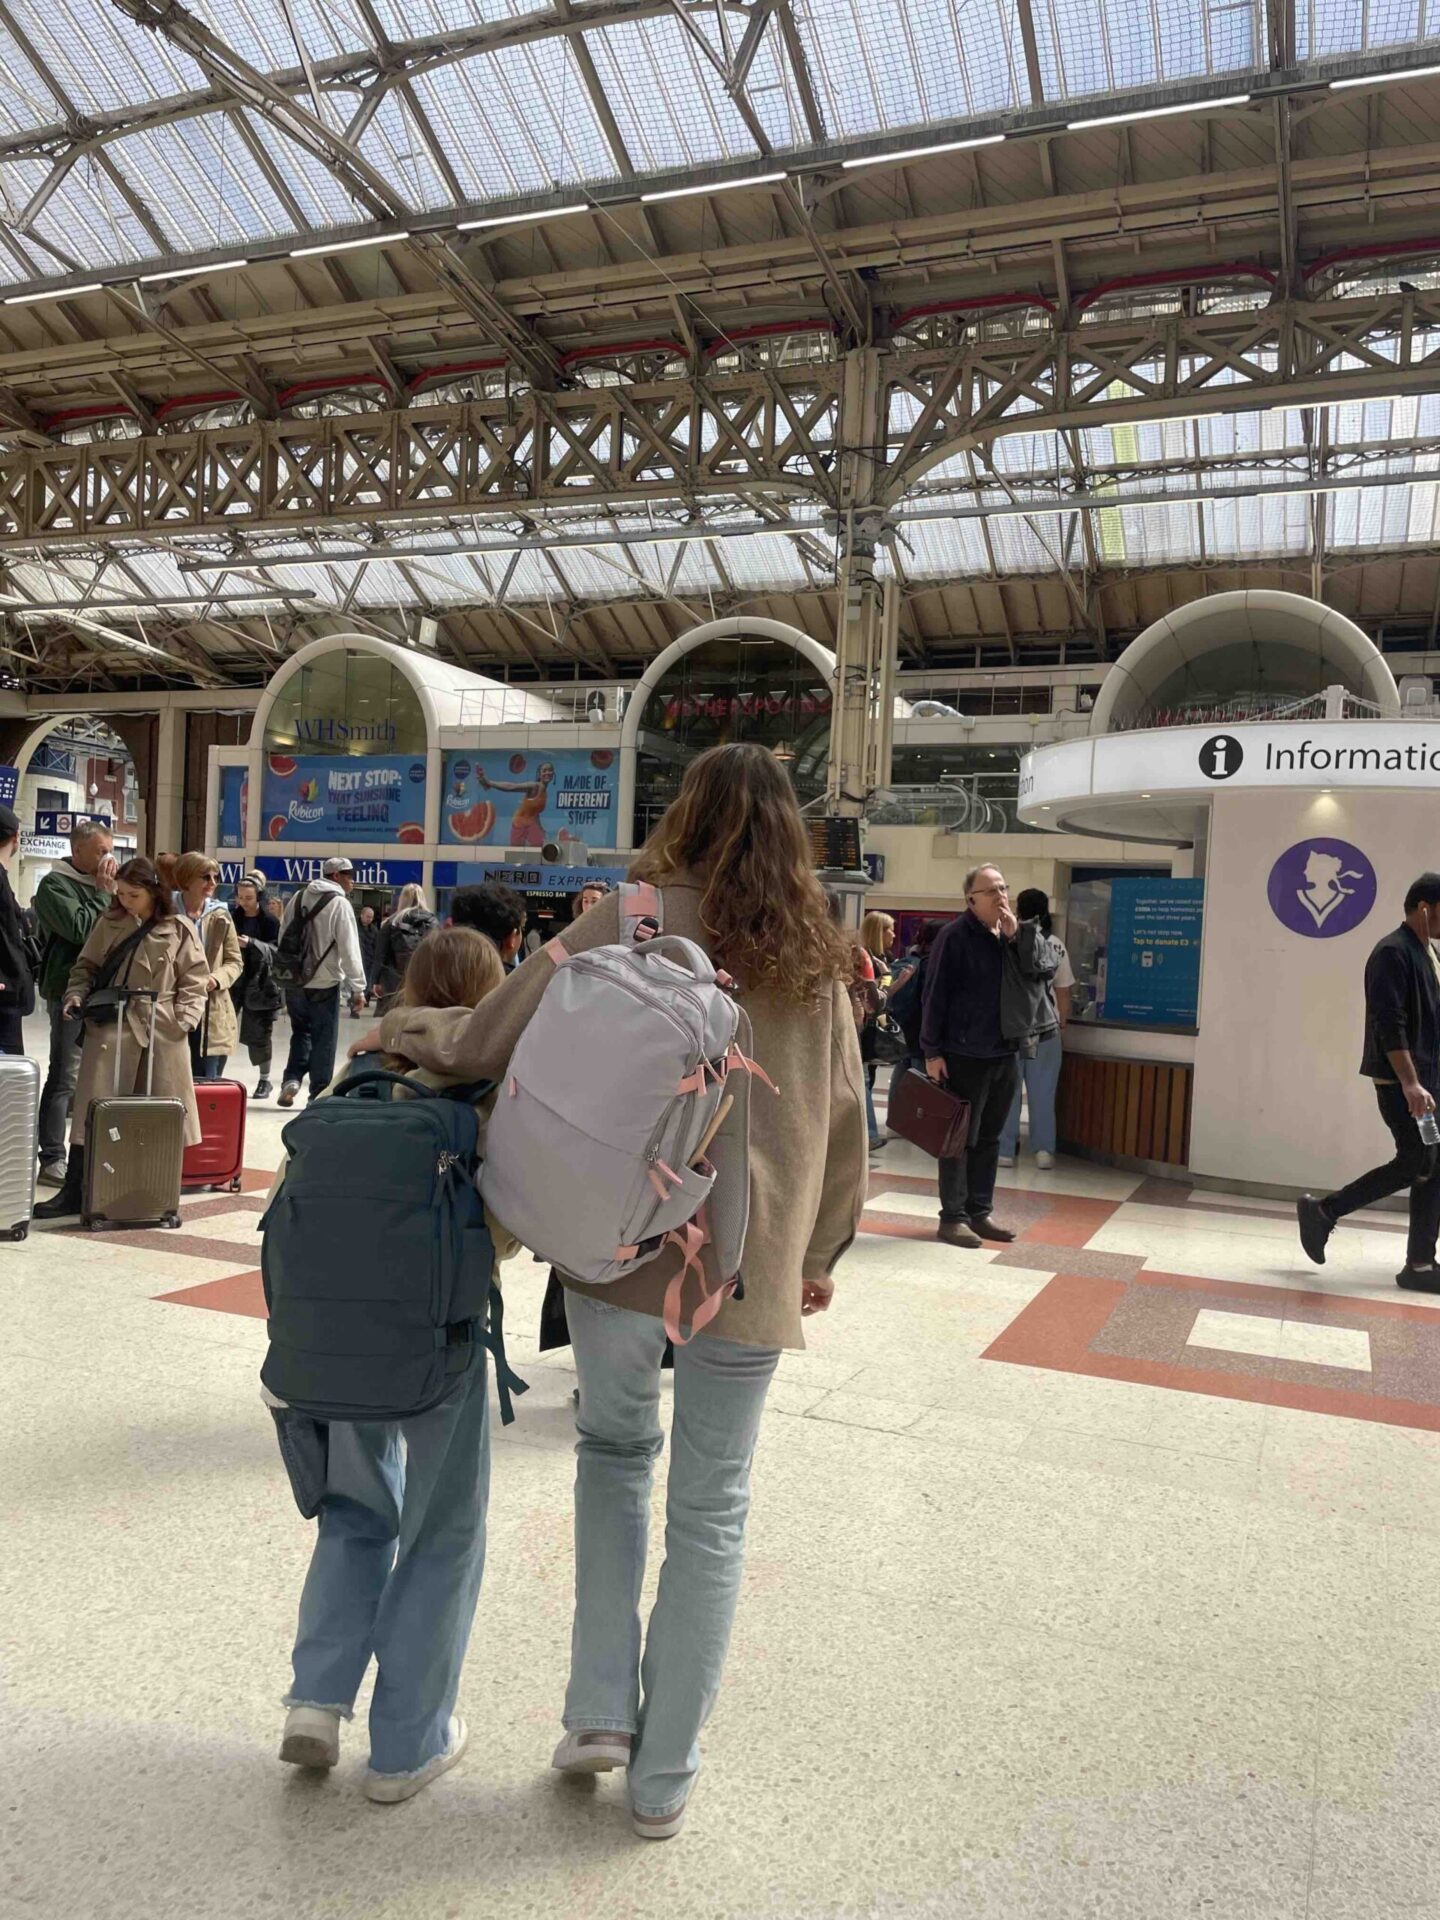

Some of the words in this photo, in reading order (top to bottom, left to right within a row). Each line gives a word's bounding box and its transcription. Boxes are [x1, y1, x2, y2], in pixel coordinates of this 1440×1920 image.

[294, 718, 397, 741] WHSmith
[328, 770, 362, 790] NEXT
[365, 769, 402, 788] STOP:
[563, 775, 592, 790] MADE
[594, 775, 607, 789] OF
[328, 789, 352, 805] THAT
[353, 788, 401, 804] SUNSHINE
[558, 791, 610, 808] DIFFERENT
[288, 800, 324, 821] Rubicon
[337, 804, 389, 823] FEELING
[568, 810, 597, 825] STUFF
[20, 838, 65, 849] EXCHANGE
[283, 858, 389, 884] WHith
[484, 870, 540, 884] NERO
[1133, 937, 1145, 945] Tap
